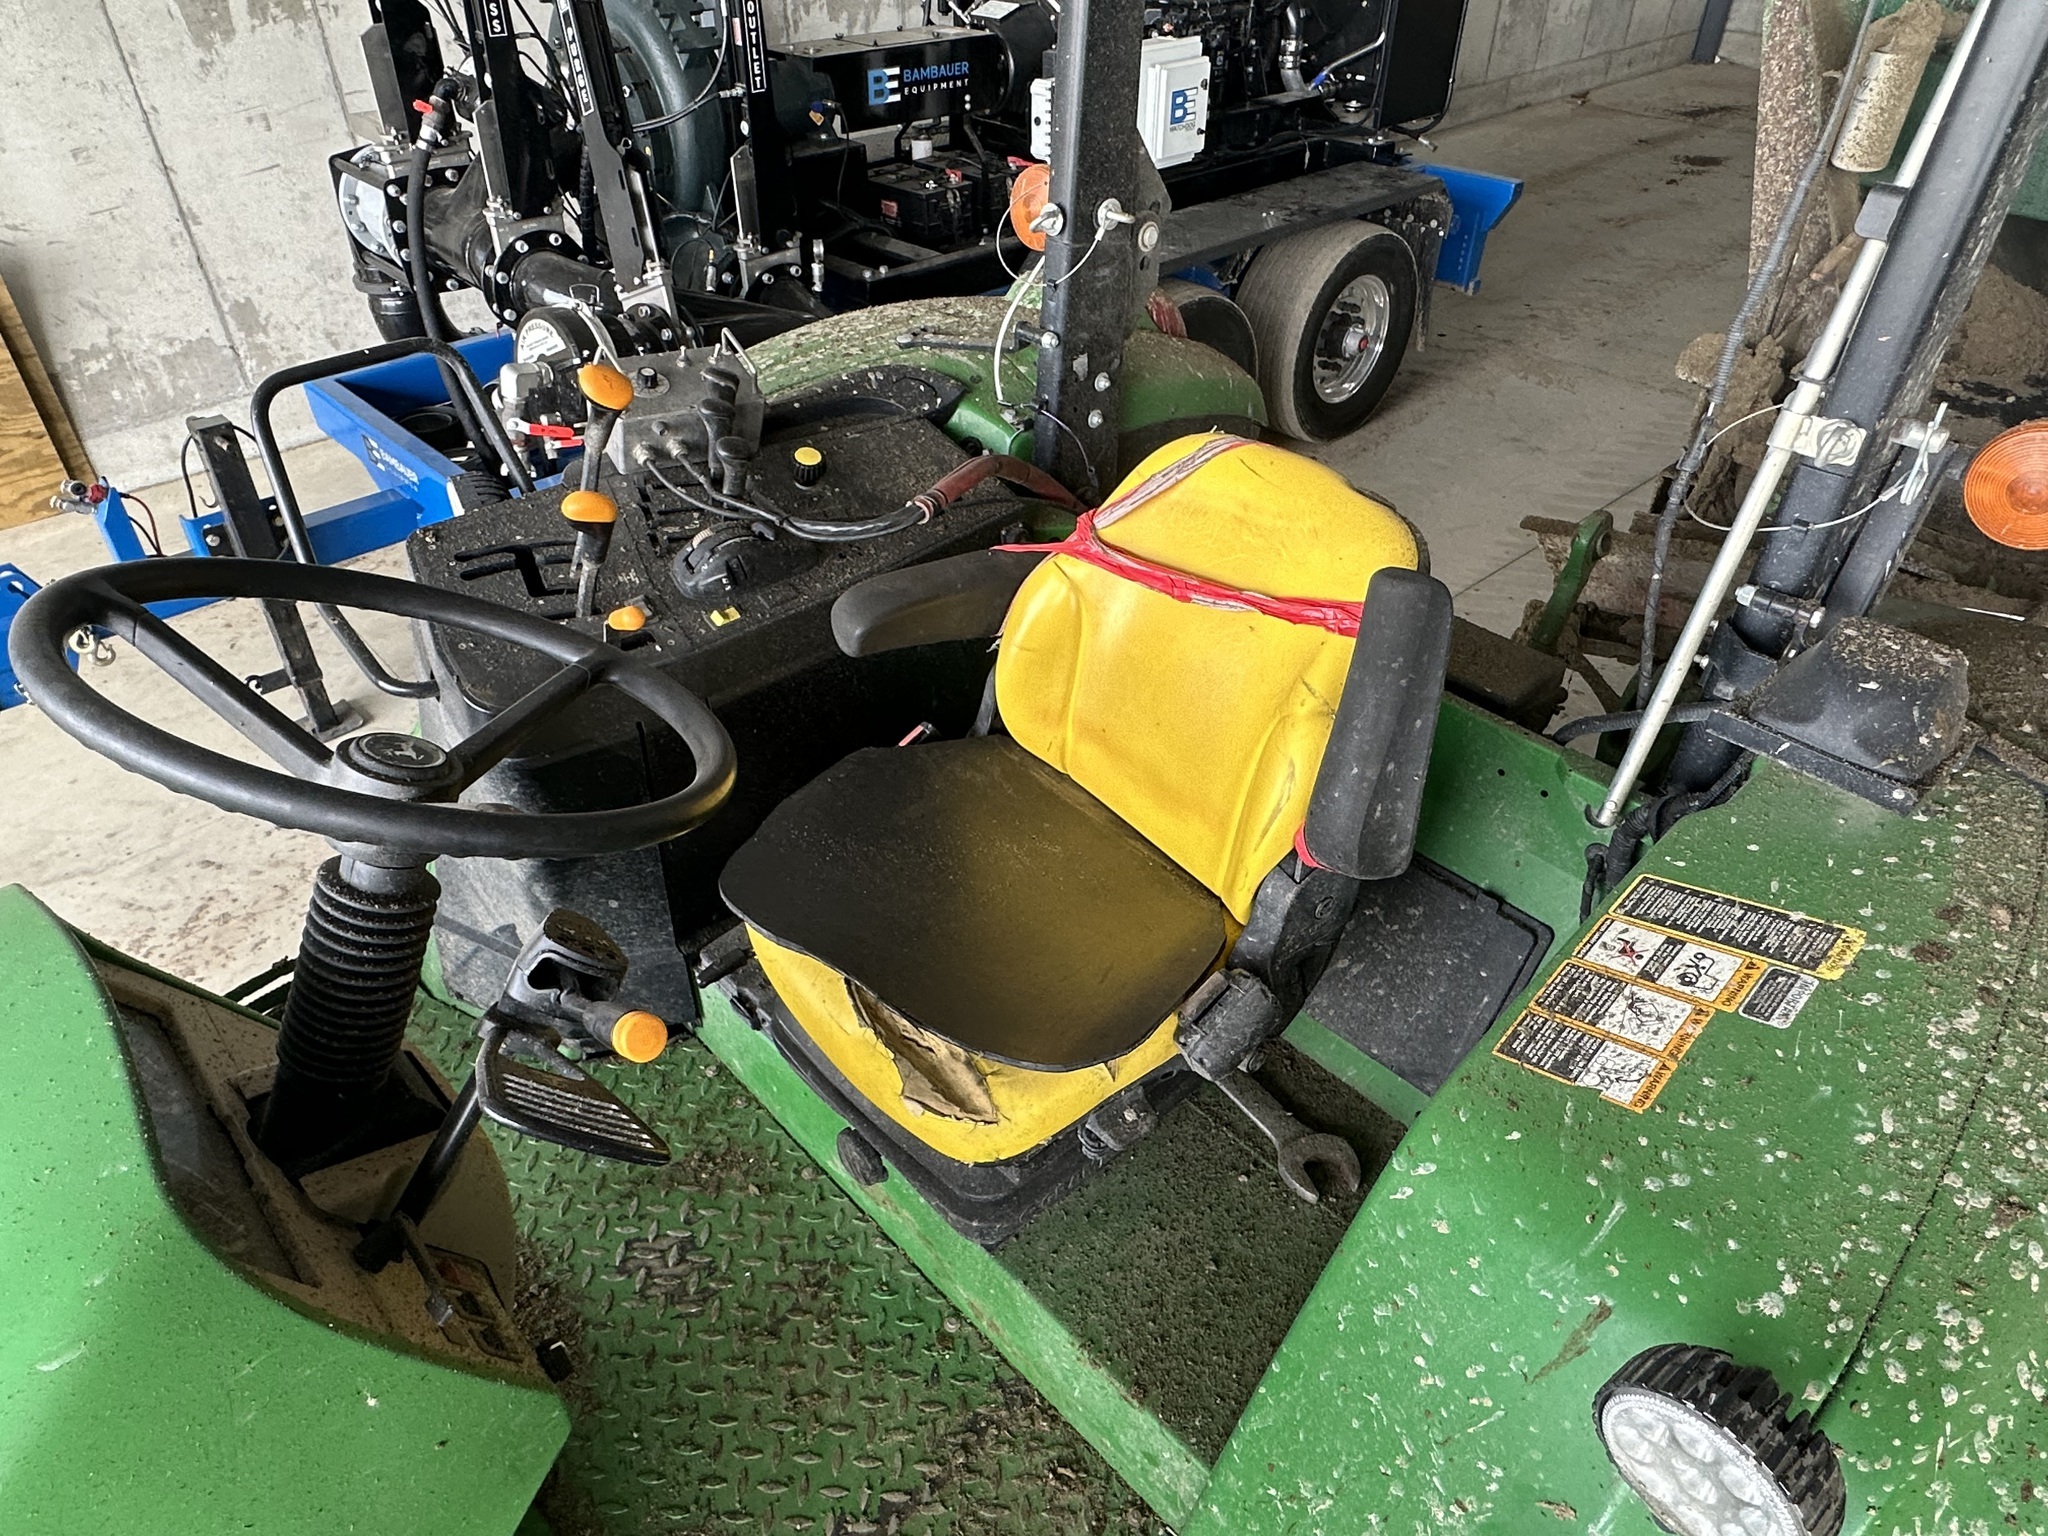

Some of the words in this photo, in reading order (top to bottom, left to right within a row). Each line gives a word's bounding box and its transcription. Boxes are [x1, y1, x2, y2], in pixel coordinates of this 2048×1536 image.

[746, 1, 761, 88] OUTLET
[567, 26, 589, 103] PURGE
[903, 61, 970, 82] BAMBAUER
[904, 78, 969, 95] EQUIPMENT
[1721, 971, 1753, 1007] WARNING
[1633, 1070, 1668, 1110] WARNING
